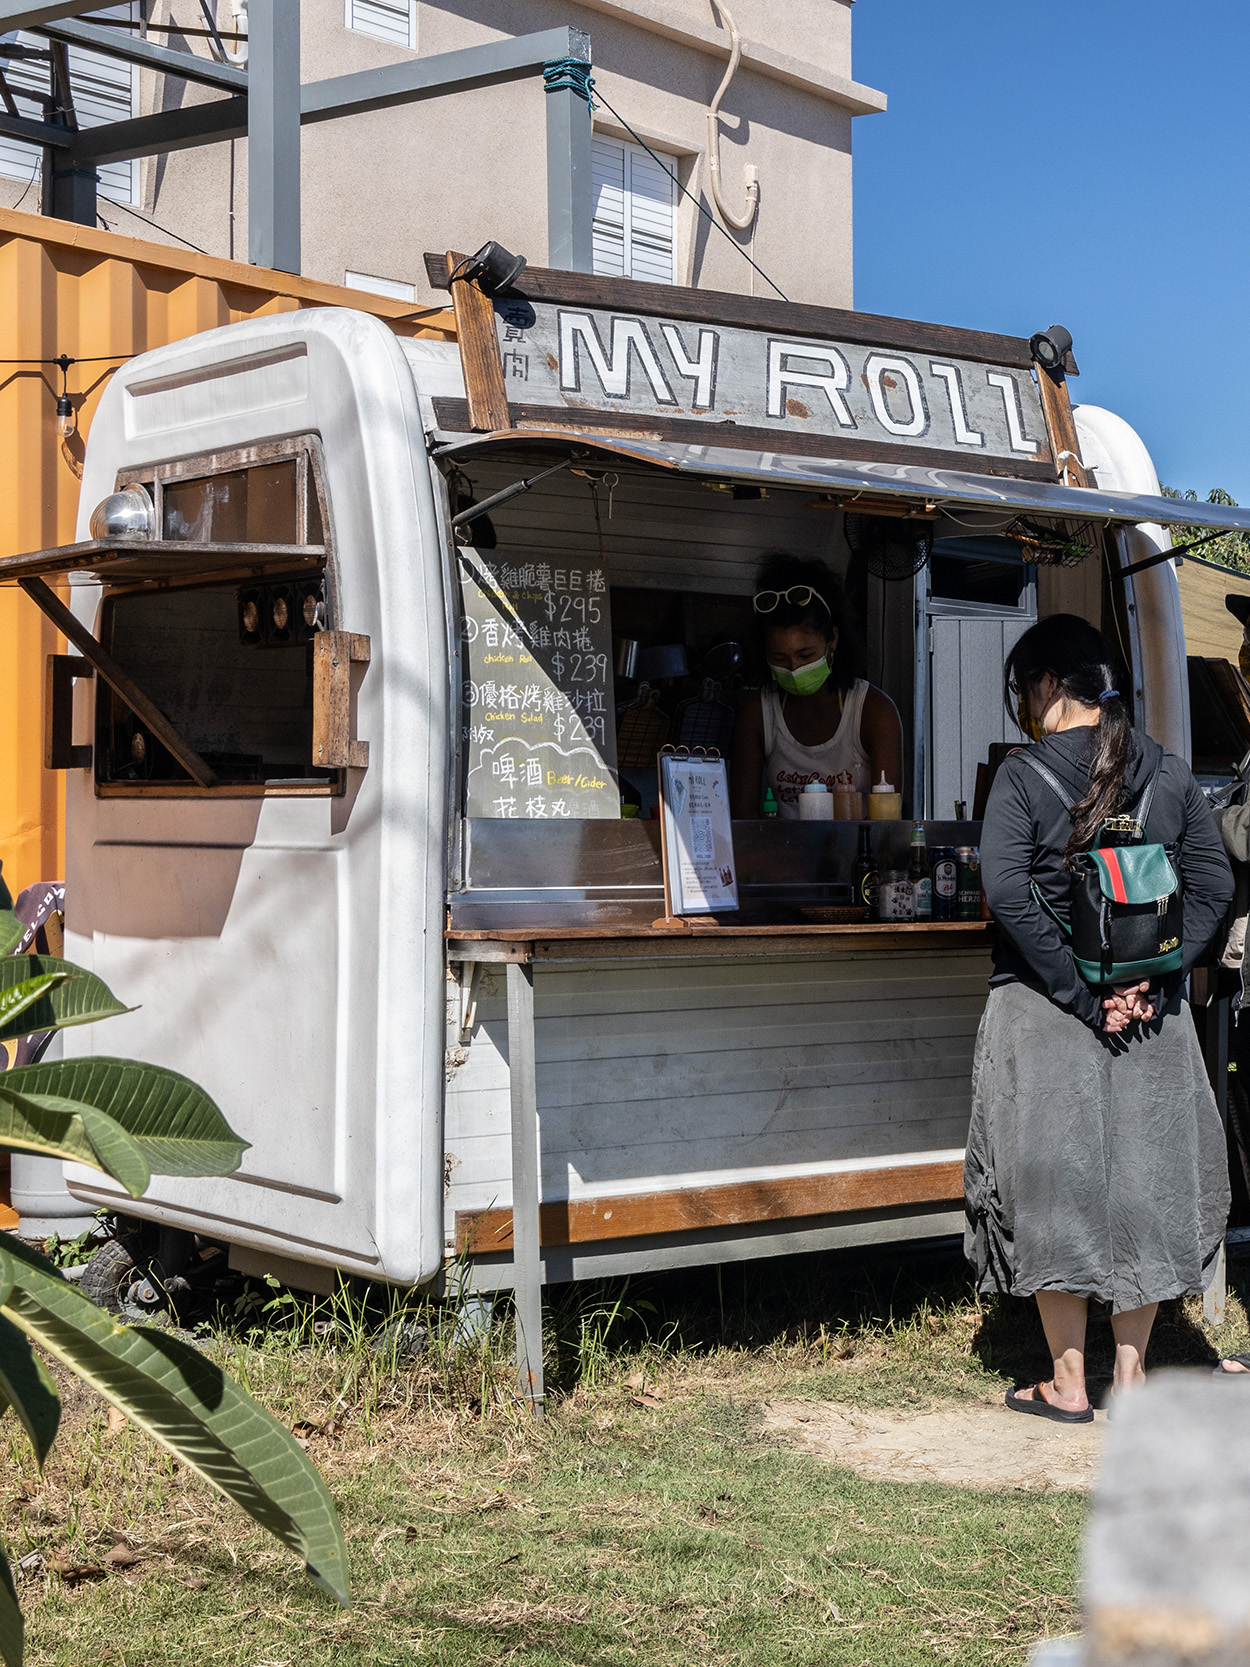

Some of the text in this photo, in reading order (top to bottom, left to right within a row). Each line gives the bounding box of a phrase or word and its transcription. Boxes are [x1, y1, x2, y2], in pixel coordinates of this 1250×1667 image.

[557, 308, 1042, 453] MY ROLL
[544, 589, 602, 624] $295
[481, 616, 596, 652] 香烤雞肉捲
[551, 652, 608, 685] $239
[479, 680, 607, 714] 優格烤雞沙拉
[553, 712, 606, 746] $239
[492, 752, 543, 790] 啤酒
[492, 794, 571, 818] 花枝丸
